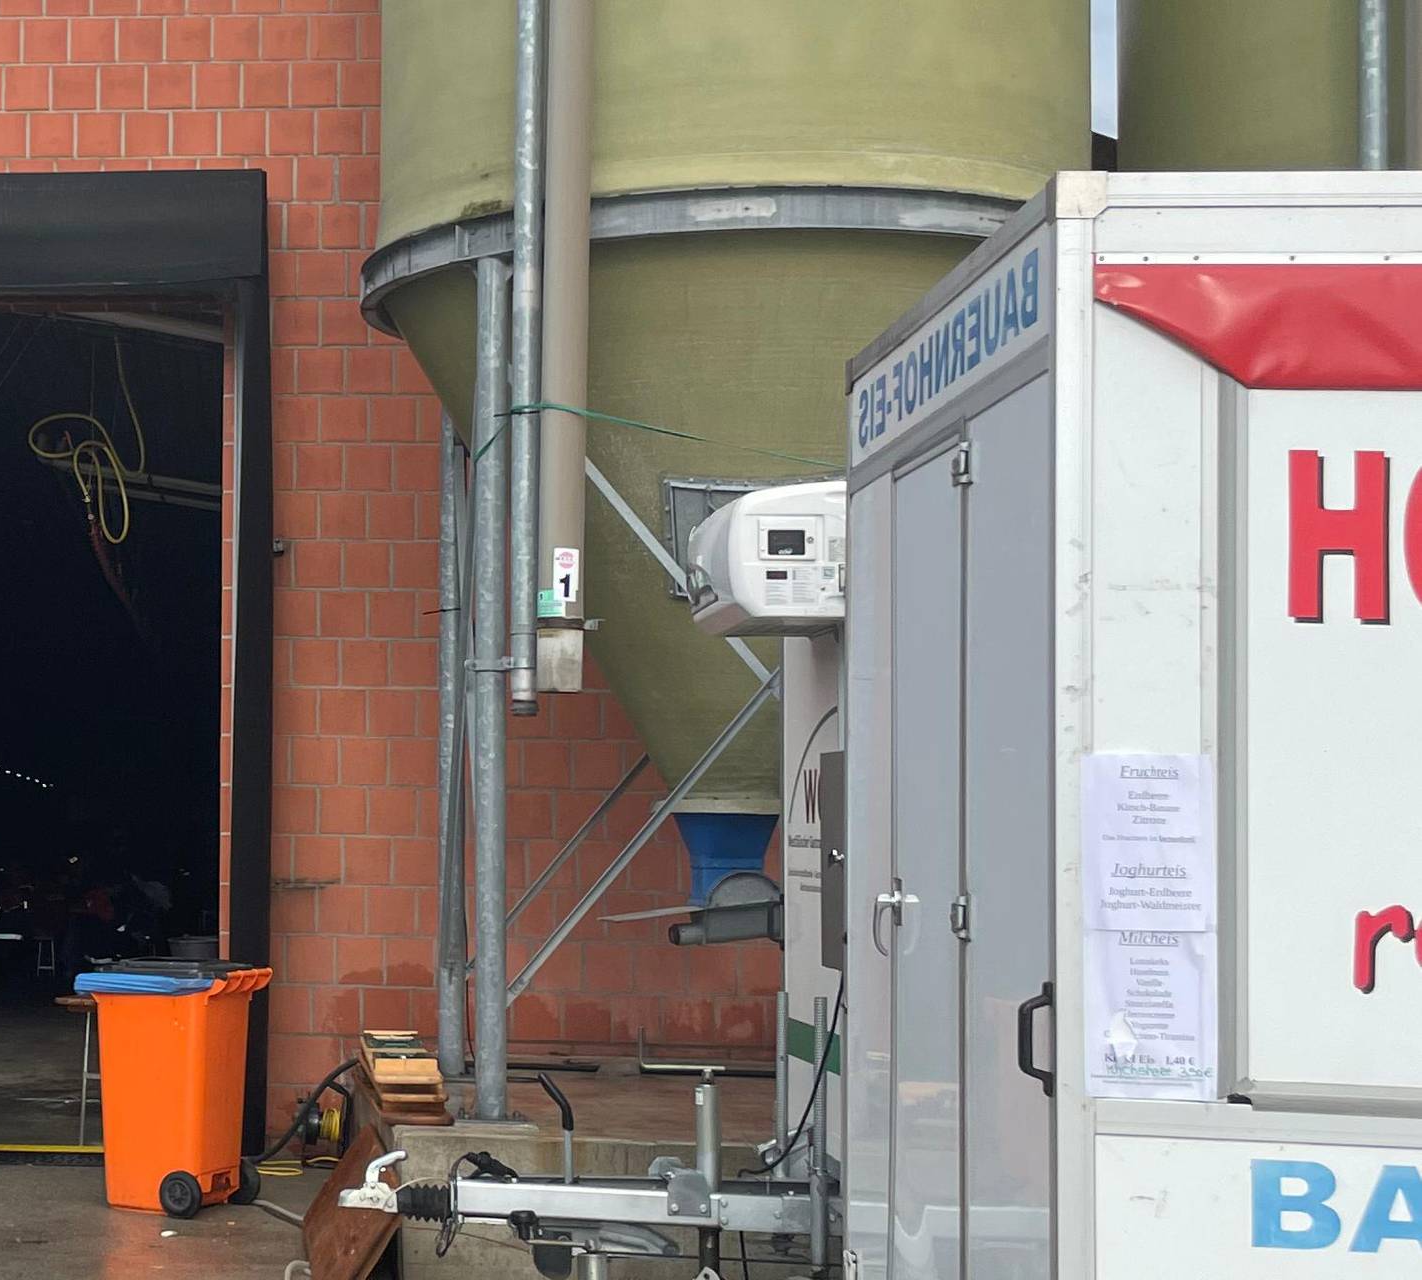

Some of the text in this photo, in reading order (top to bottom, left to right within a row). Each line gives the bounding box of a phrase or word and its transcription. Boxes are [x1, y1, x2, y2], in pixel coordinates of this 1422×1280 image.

[1287, 449, 1422, 626] H
[559, 573, 571, 598] 1
[1120, 765, 1180, 780] Fruchteis
[803, 768, 821, 824] W
[1110, 862, 1187, 879] Joghurteis
[1108, 887, 1193, 898] Joghurt-Erdbeere
[1119, 931, 1180, 947] Milcheis
[1353, 904, 1422, 994] r
